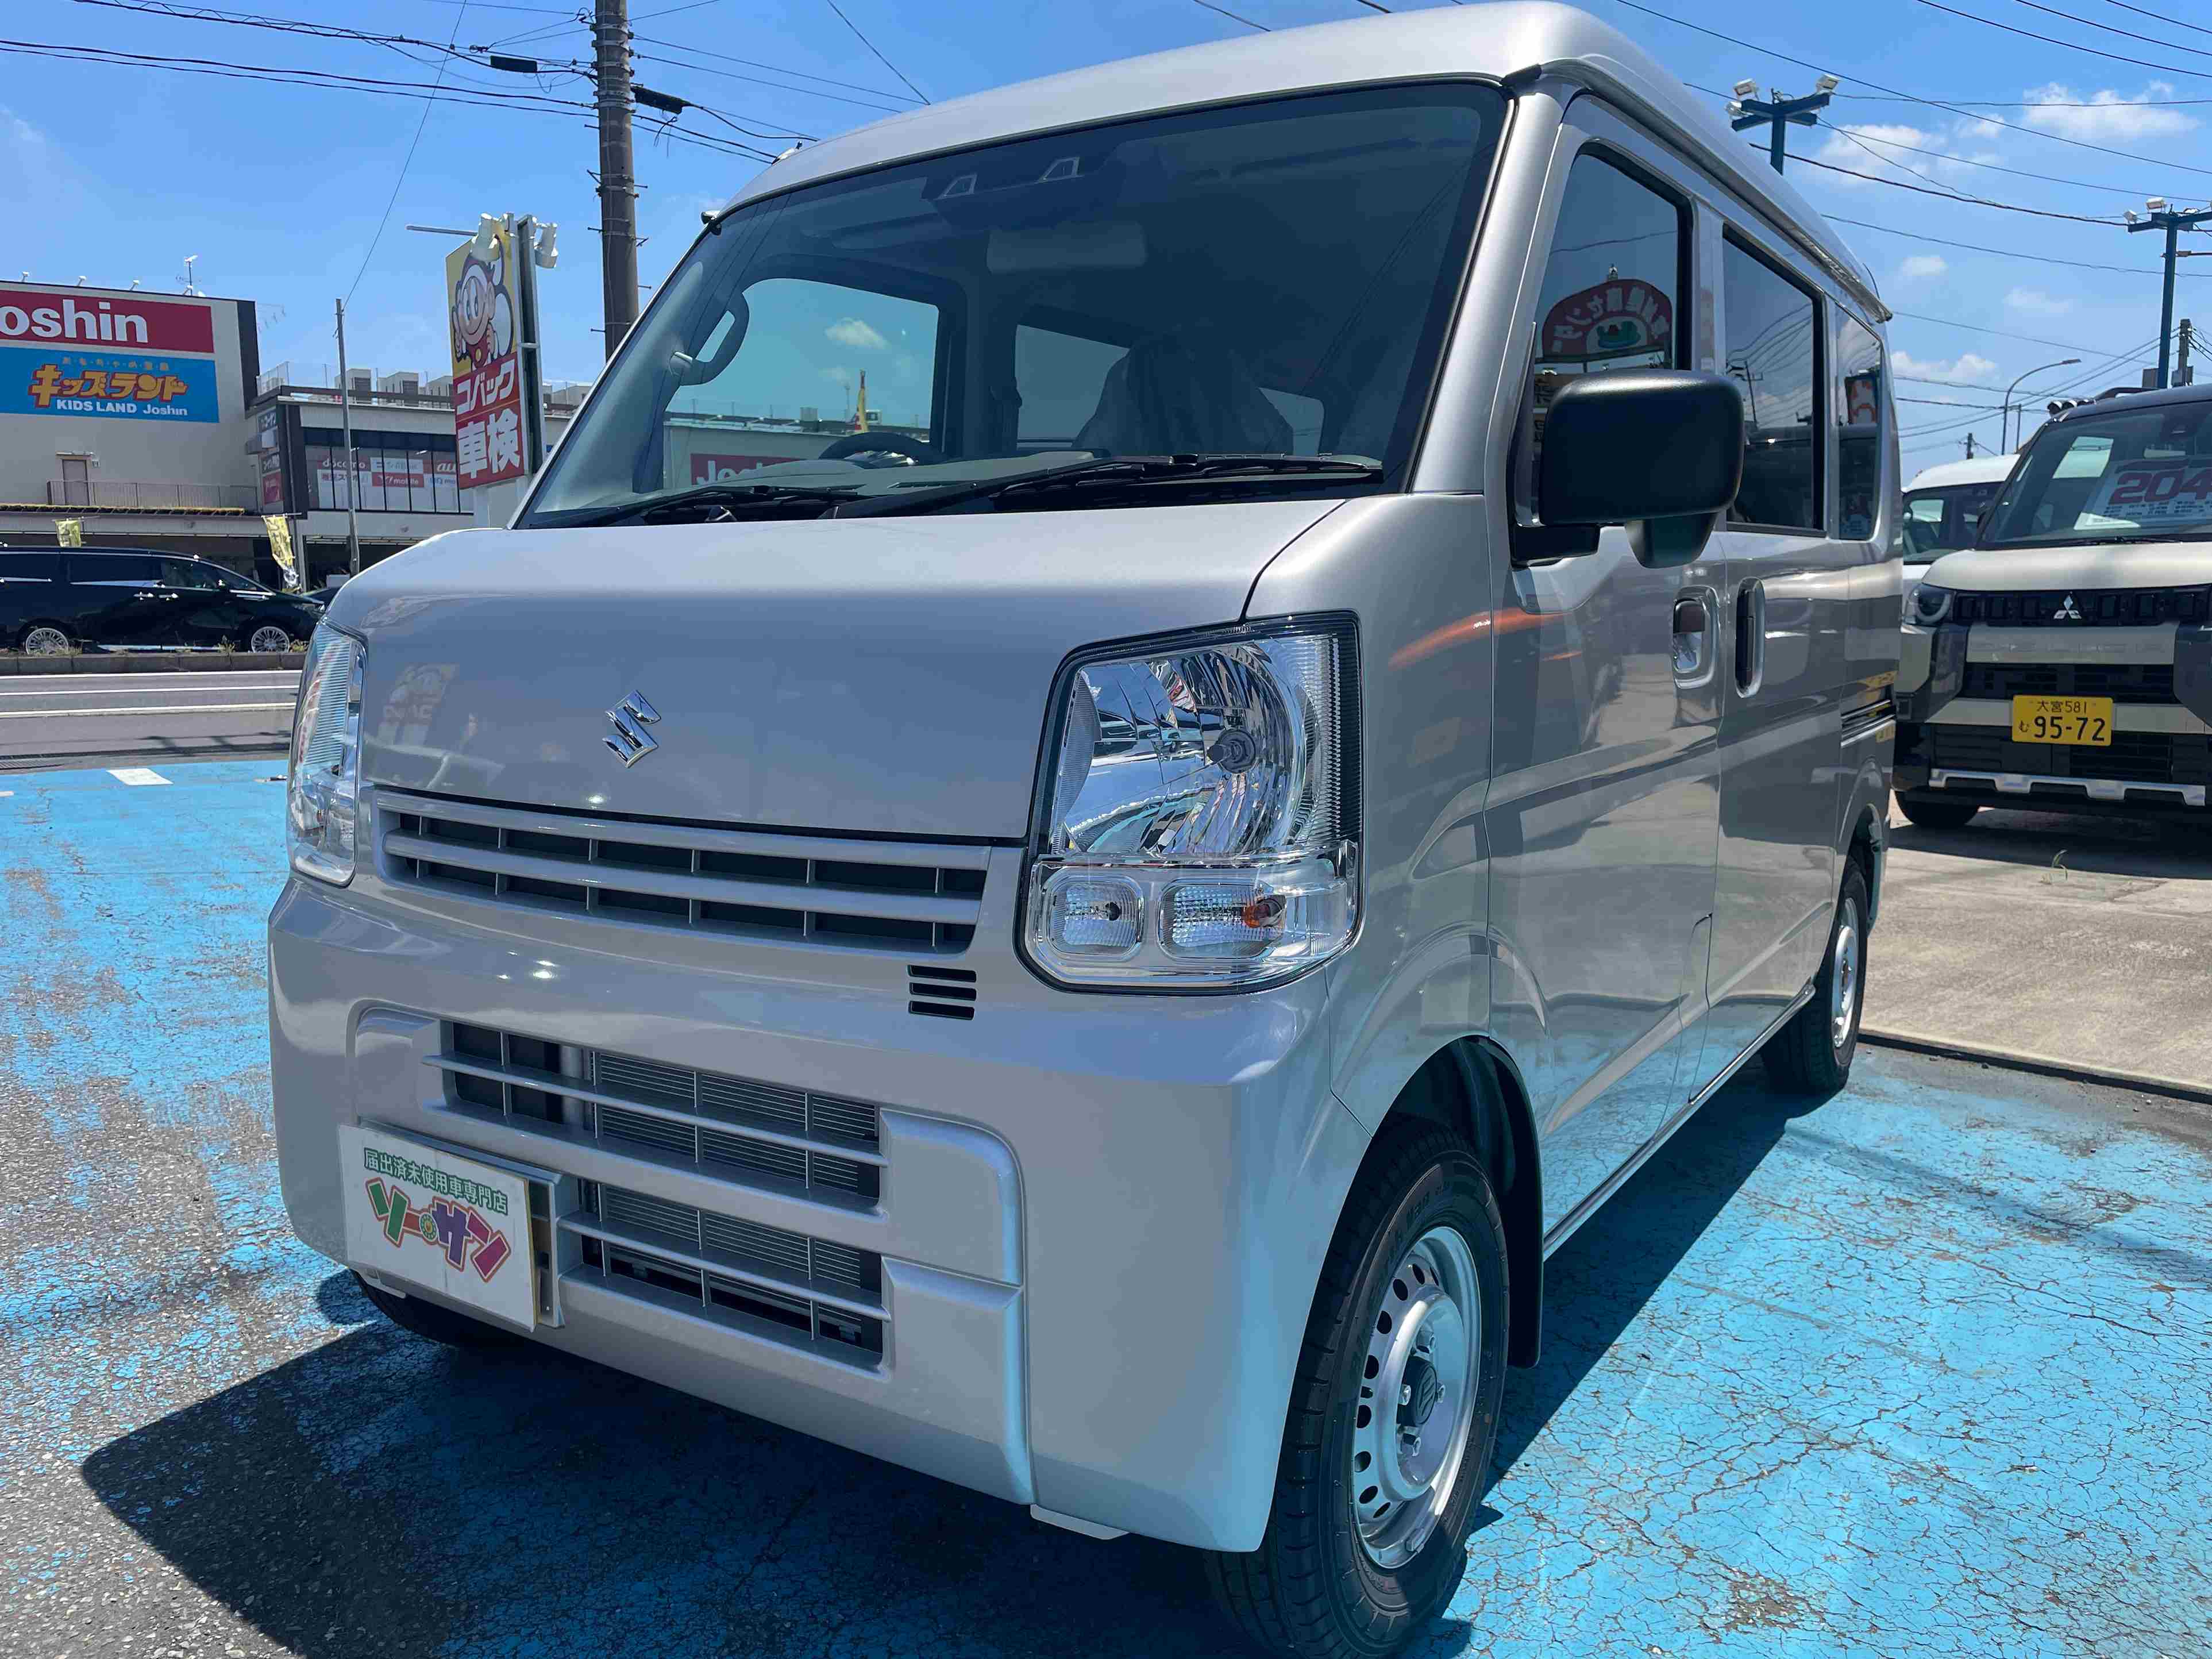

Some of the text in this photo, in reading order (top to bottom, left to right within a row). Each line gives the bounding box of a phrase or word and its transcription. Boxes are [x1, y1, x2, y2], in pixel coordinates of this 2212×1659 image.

[29, 363, 188, 408] キッズランド
[56, 399, 188, 416] KIDS LAND Joshin
[457, 359, 515, 415] コバック
[458, 408, 521, 479] 車検
[2034, 715, 2106, 742] 95-72
[364, 1148, 508, 1215] 届出済未使用車専門店
